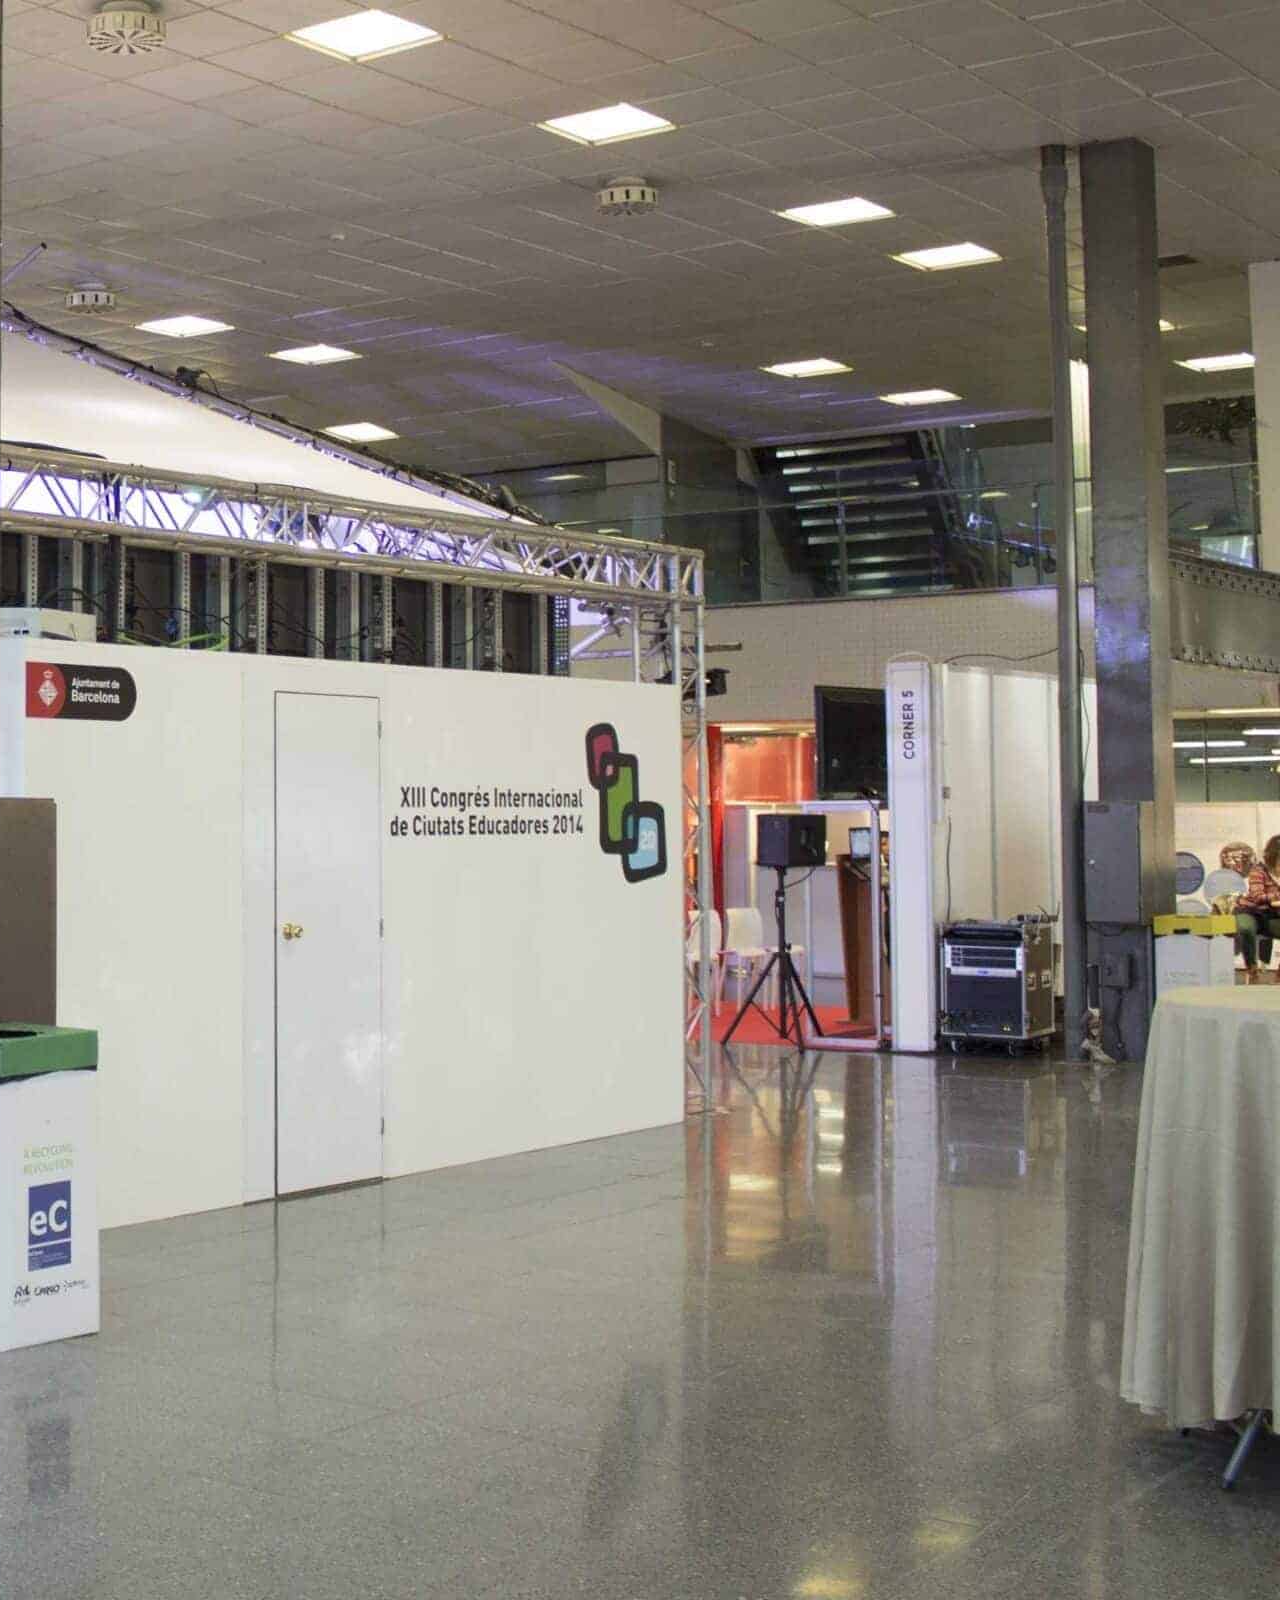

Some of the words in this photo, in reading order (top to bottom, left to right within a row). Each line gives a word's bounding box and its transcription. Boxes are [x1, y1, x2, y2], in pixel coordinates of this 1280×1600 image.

[72, 677, 110, 689] Ajuntament
[72, 689, 120, 704] Barcelona
[902, 690, 914, 698] 5
[902, 703, 915, 760] CORNER
[400, 786, 426, 808] XIII
[431, 785, 489, 812] Congrés
[494, 787, 583, 809] Internacional
[390, 816, 408, 836] de
[413, 815, 464, 836] Ciutats
[470, 815, 549, 835] Educadores
[553, 815, 583, 834] 2014
[30, 1200, 67, 1236] eC
